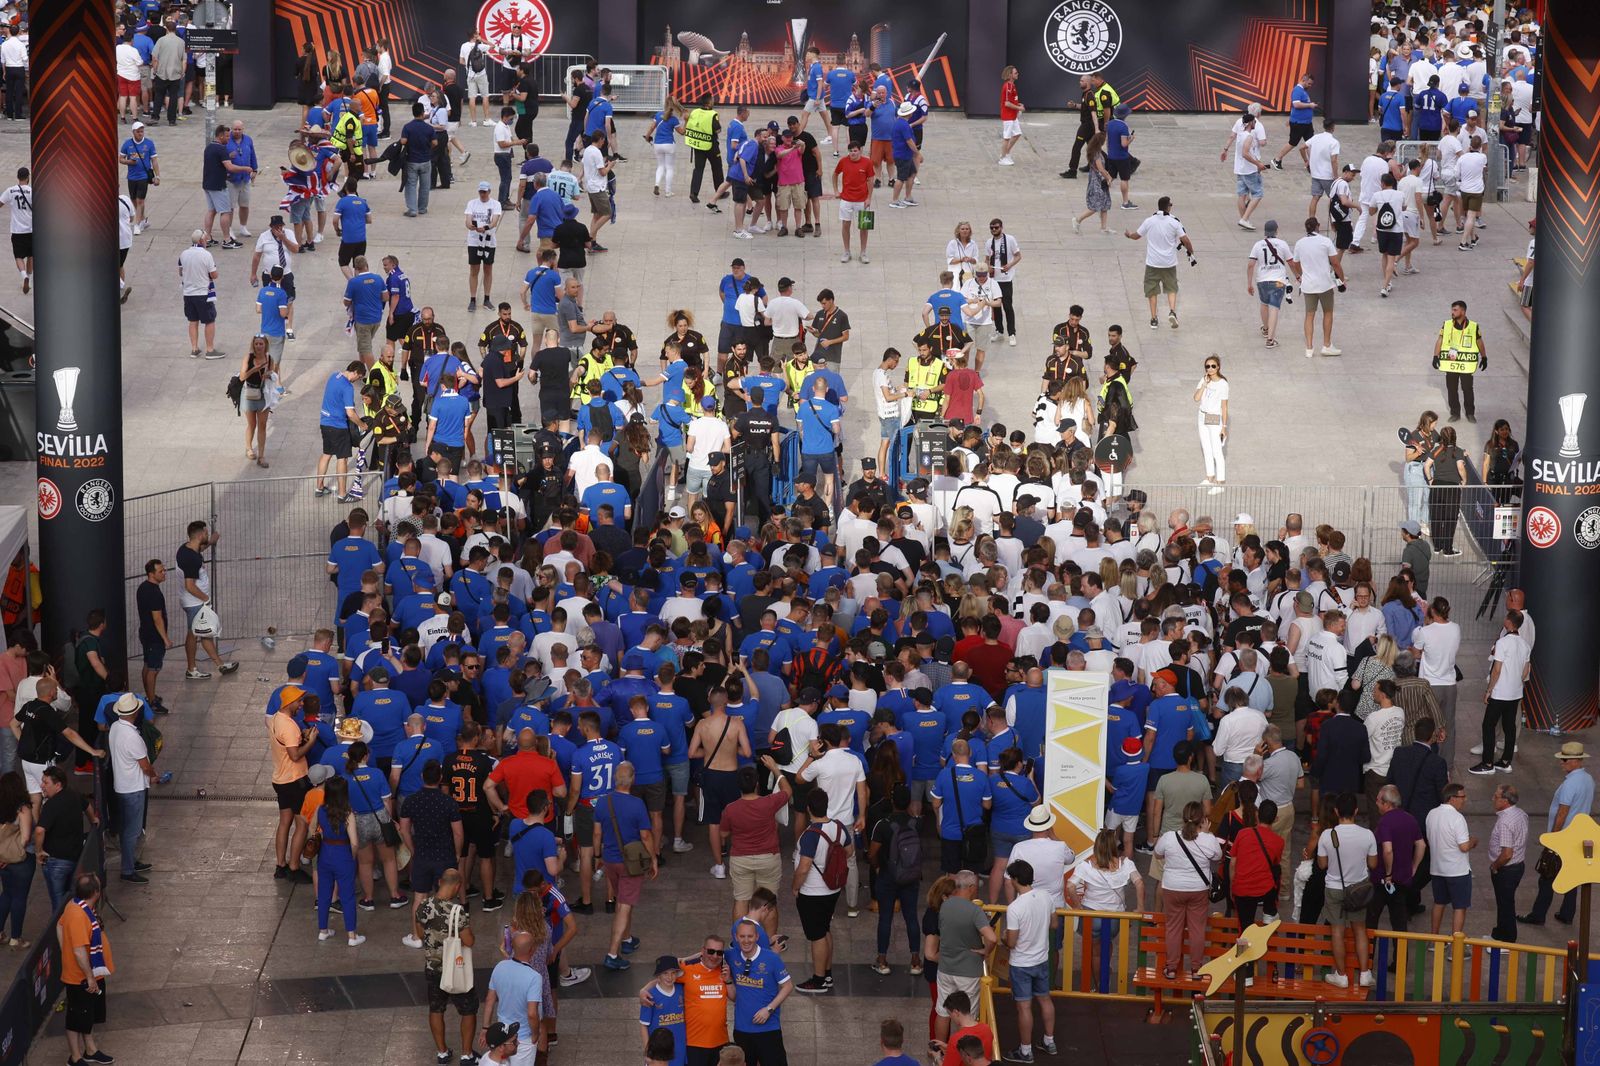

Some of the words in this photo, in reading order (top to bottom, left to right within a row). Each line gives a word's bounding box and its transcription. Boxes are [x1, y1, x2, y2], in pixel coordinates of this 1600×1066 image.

[1053, 0, 1114, 23] RANGERS
[1049, 42, 1097, 71] FOOTBALL
[1097, 42, 1117, 66] CLUB
[1422, 94, 1436, 111] 11
[686, 129, 712, 141] TEWARD
[552, 181, 567, 198] 16
[1262, 247, 1278, 265] 13
[1440, 352, 1477, 361] STWARD
[1450, 363, 1466, 371] 576
[40, 456, 71, 468] FINAL
[73, 456, 105, 468] 2022
[80, 480, 111, 493] RANGERS
[1535, 482, 1571, 495] FINAL
[1574, 484, 1600, 495] 2022
[78, 504, 104, 520] FOOTBALL
[427, 628, 449, 636] Eintra
[588, 763, 613, 791] 31
[451, 776, 478, 802] 31
[736, 974, 764, 985] 32Red
